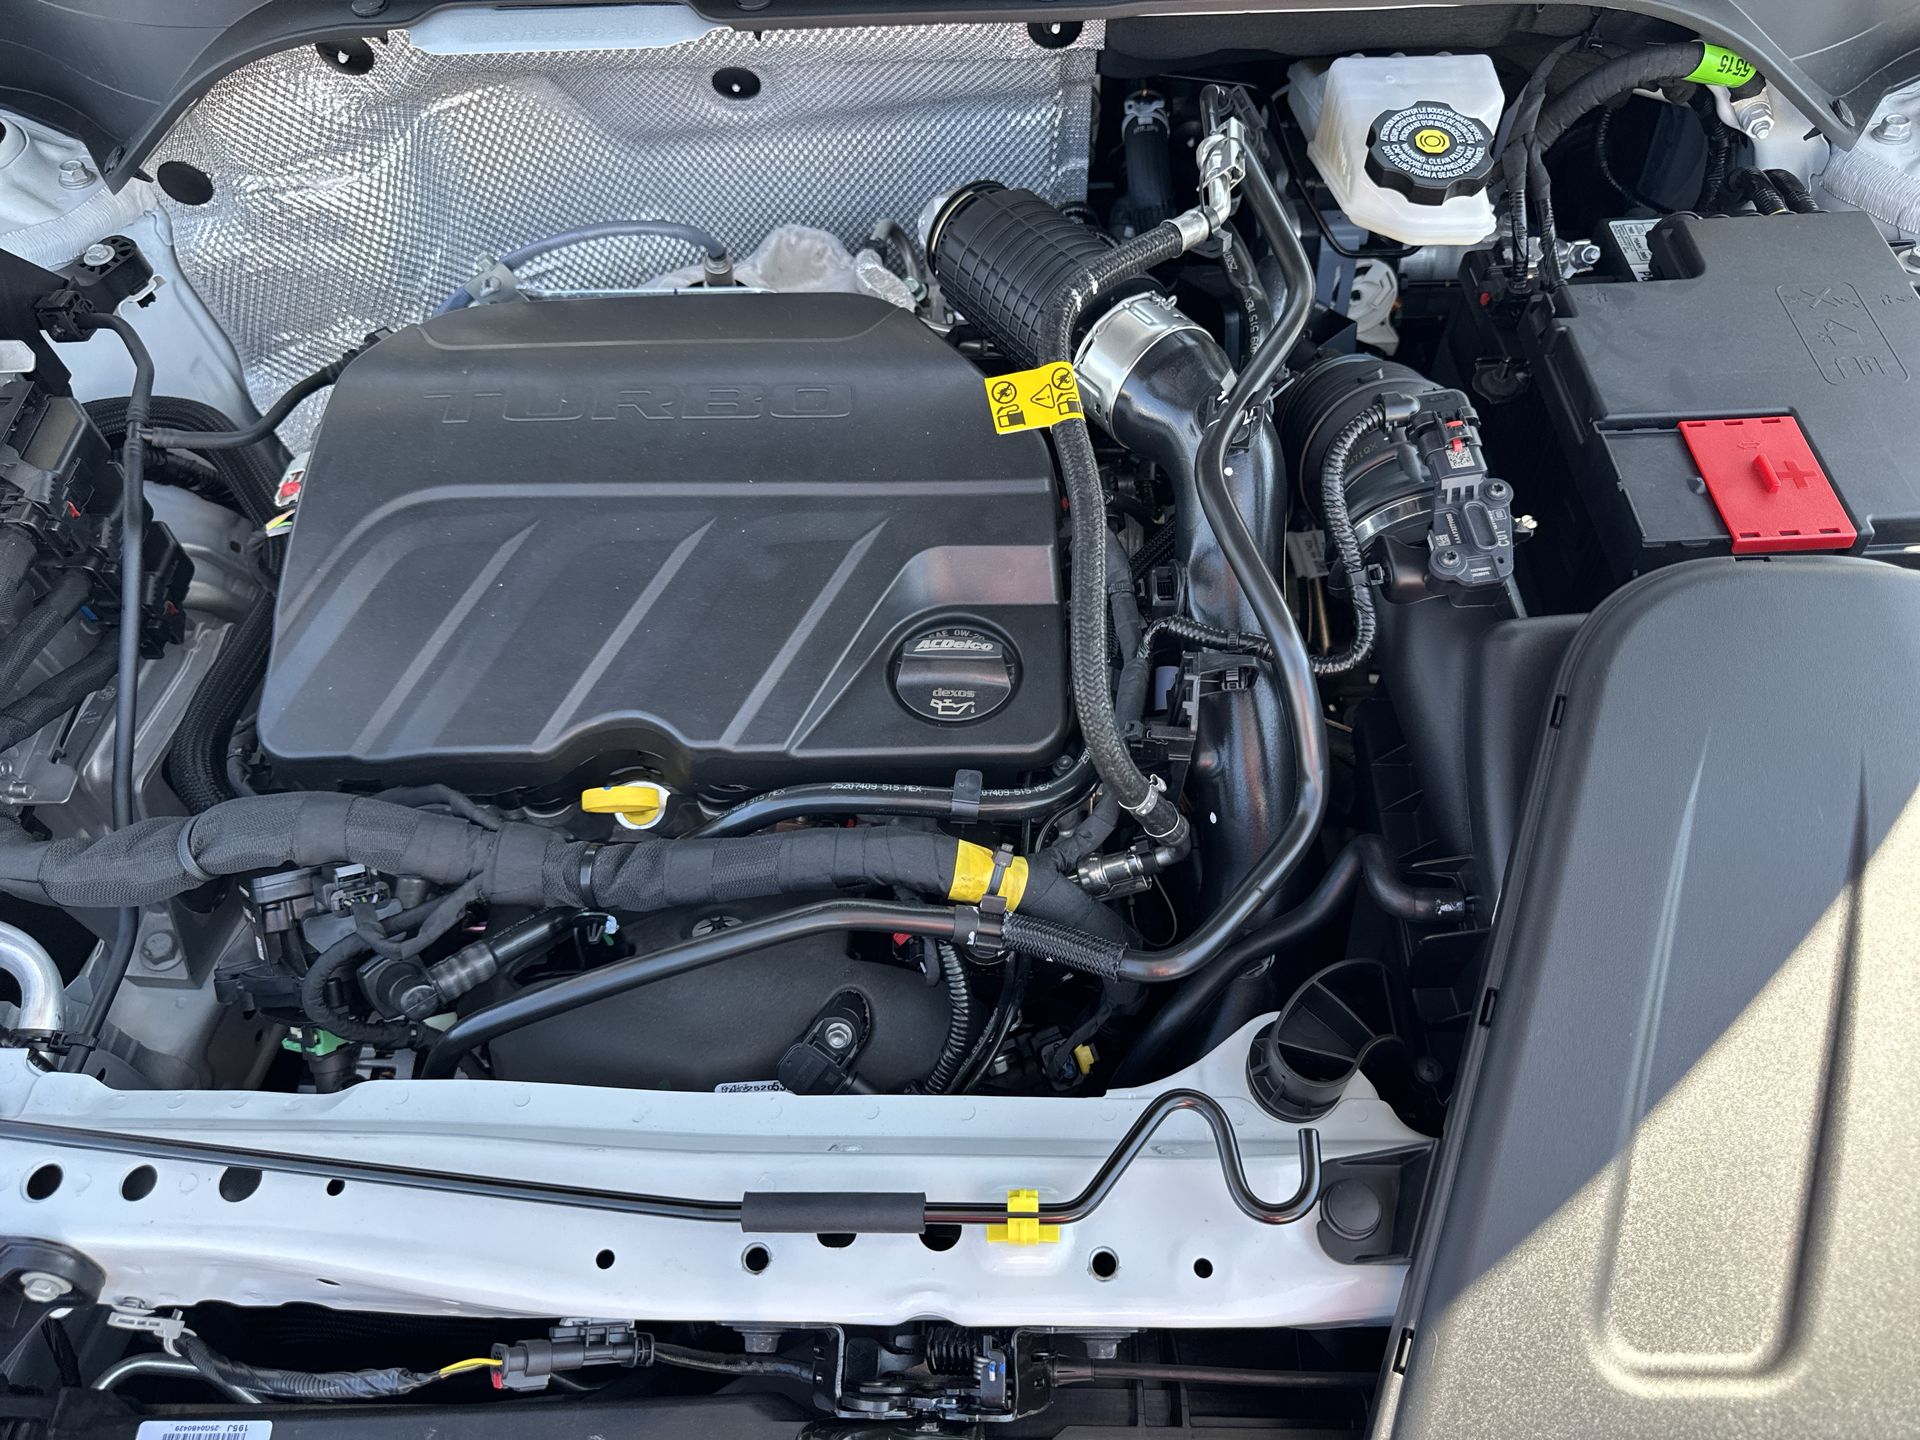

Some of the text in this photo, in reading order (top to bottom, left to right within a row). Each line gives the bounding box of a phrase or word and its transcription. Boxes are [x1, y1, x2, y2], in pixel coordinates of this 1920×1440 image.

[1409, 167, 1431, 178] FROM
[1437, 167, 1464, 178] SEALED
[1244, 296, 1255, 313] MEX
[1249, 314, 1259, 333] 515
[423, 384, 853, 424] TURBO
[914, 639, 994, 651] ACDelco
[932, 688, 976, 698] dexos
[831, 782, 922, 793] 25207409 515 MEX
[981, 789, 1010, 797] 07409
[1014, 788, 1031, 796] 515
[227, 1424, 249, 1432] 195J
